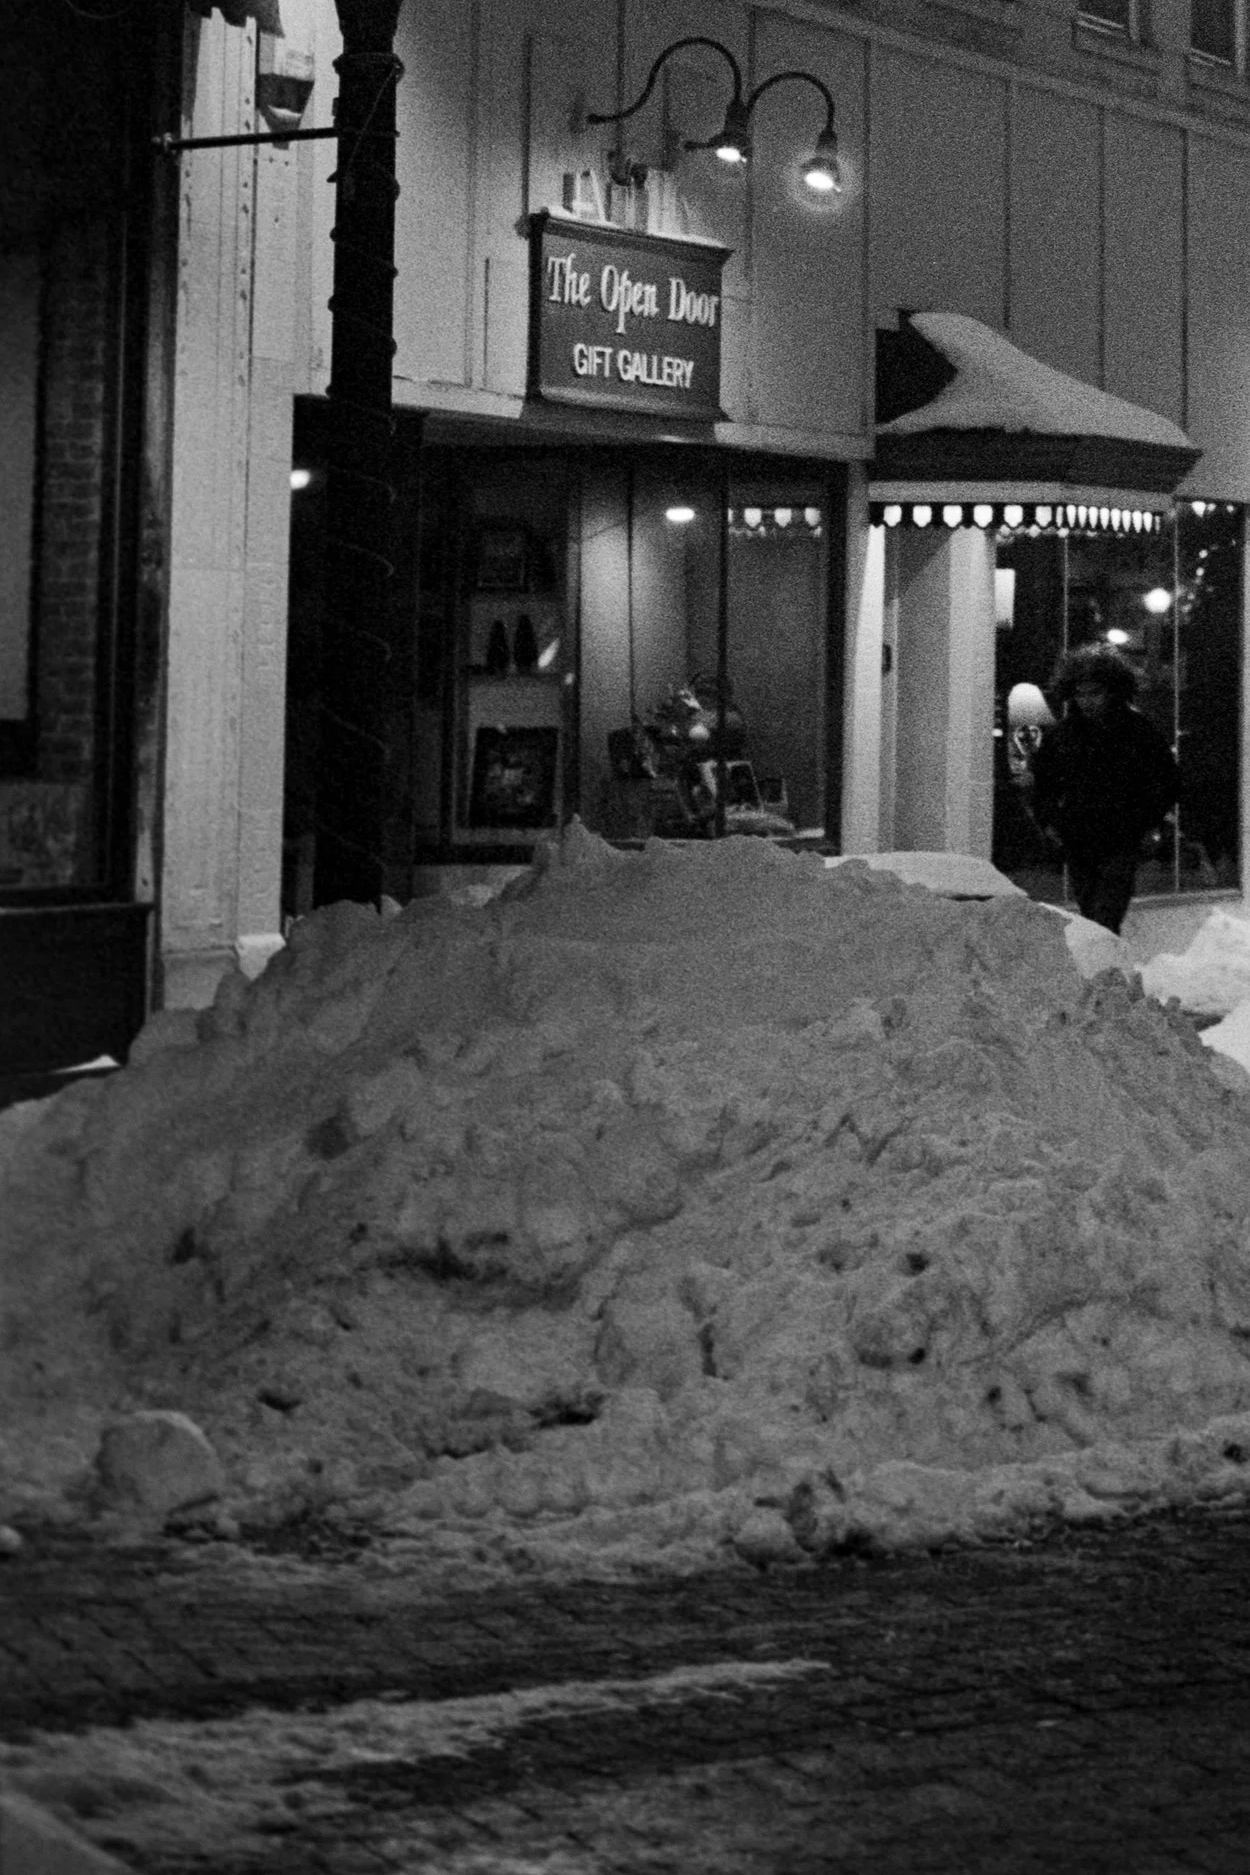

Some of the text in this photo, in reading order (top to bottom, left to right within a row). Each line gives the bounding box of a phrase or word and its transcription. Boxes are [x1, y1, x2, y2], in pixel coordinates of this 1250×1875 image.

[548, 253, 719, 334] The Open Door
[573, 343, 694, 389] GIFT GALLERY
